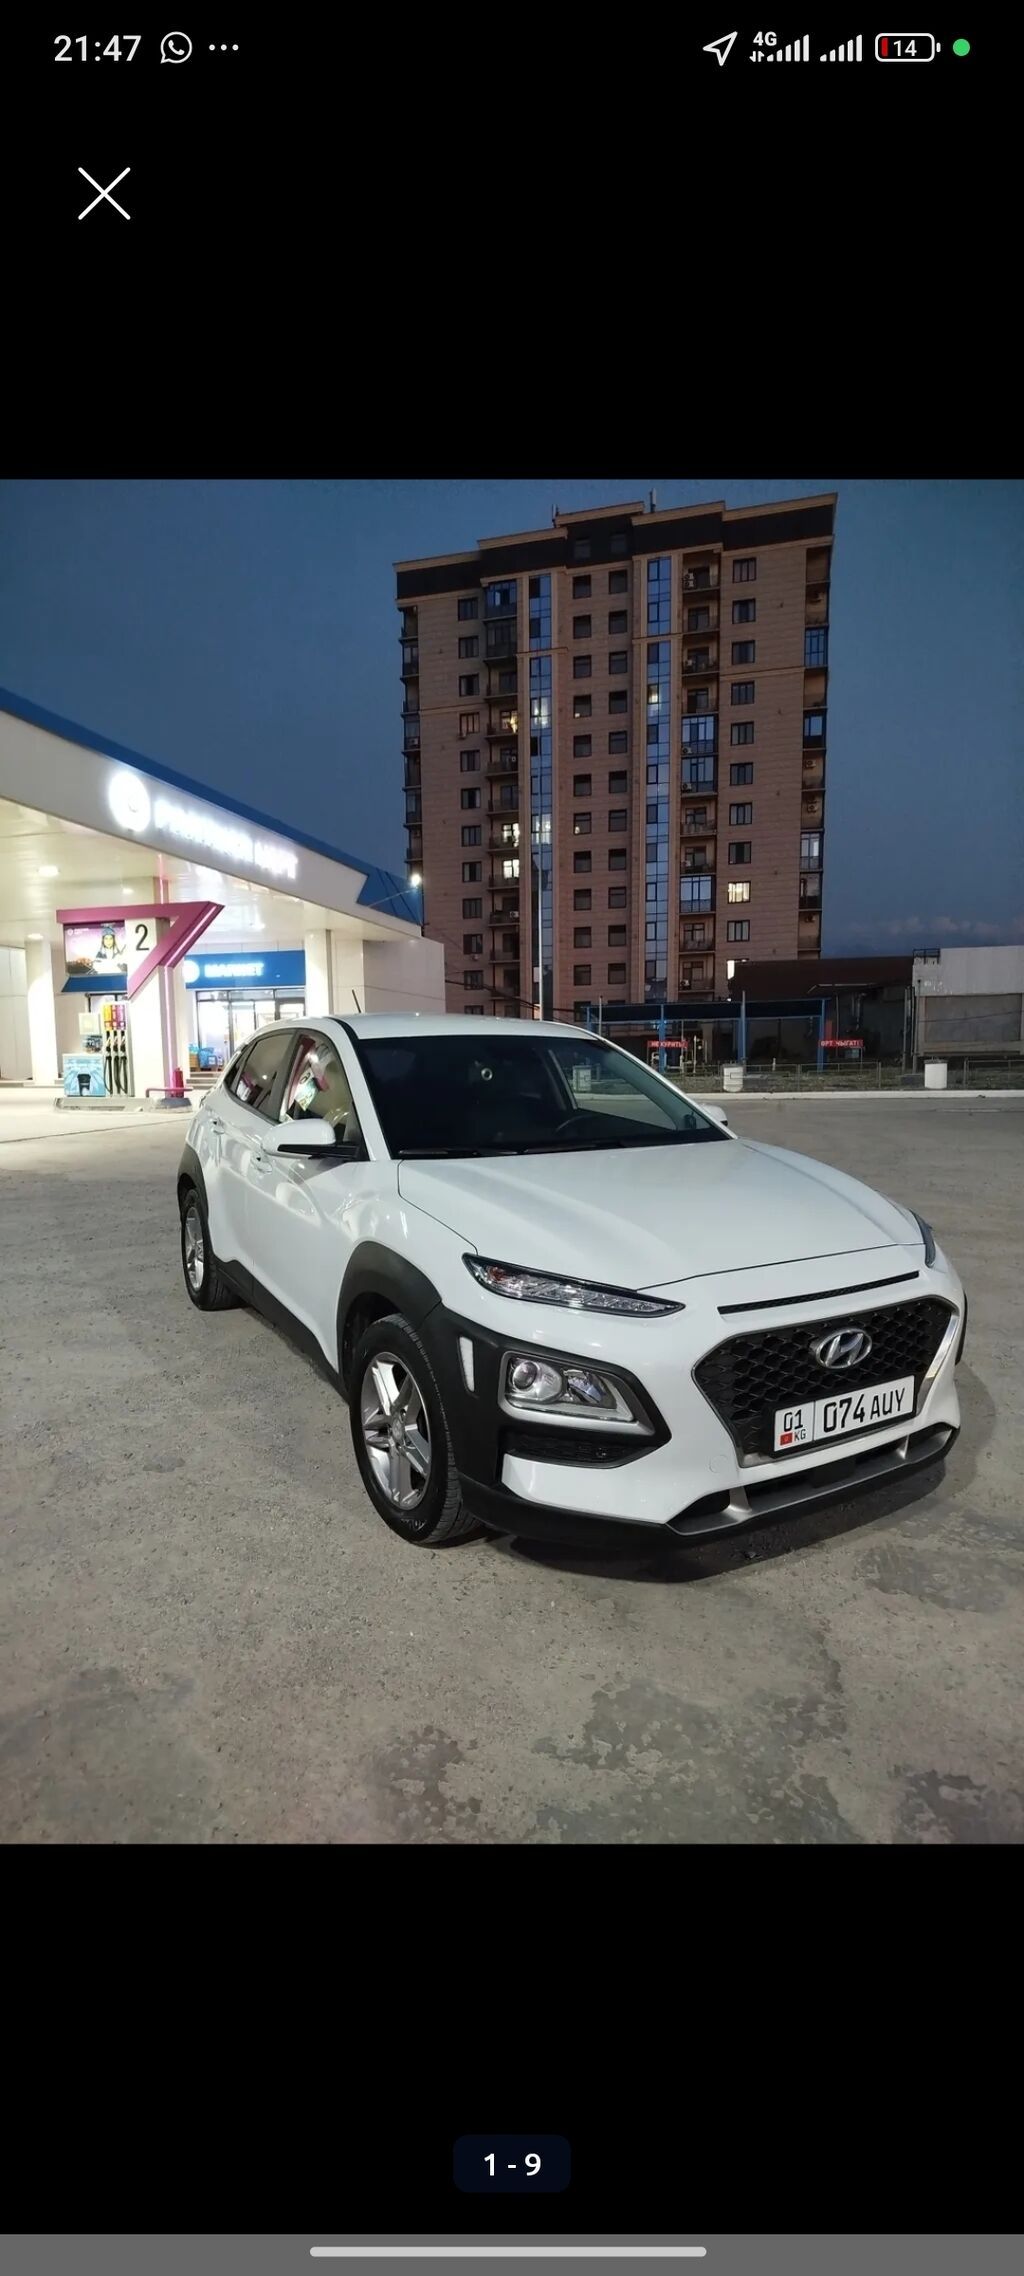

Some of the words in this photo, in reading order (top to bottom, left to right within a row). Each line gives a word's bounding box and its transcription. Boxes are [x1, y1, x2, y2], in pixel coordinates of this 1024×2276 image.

[135, 923, 150, 951] 2
[783, 1409, 804, 1432] 01
[823, 1394, 865, 1433] 074
[870, 1387, 905, 1420] AUY
[794, 1429, 806, 1442] KG
